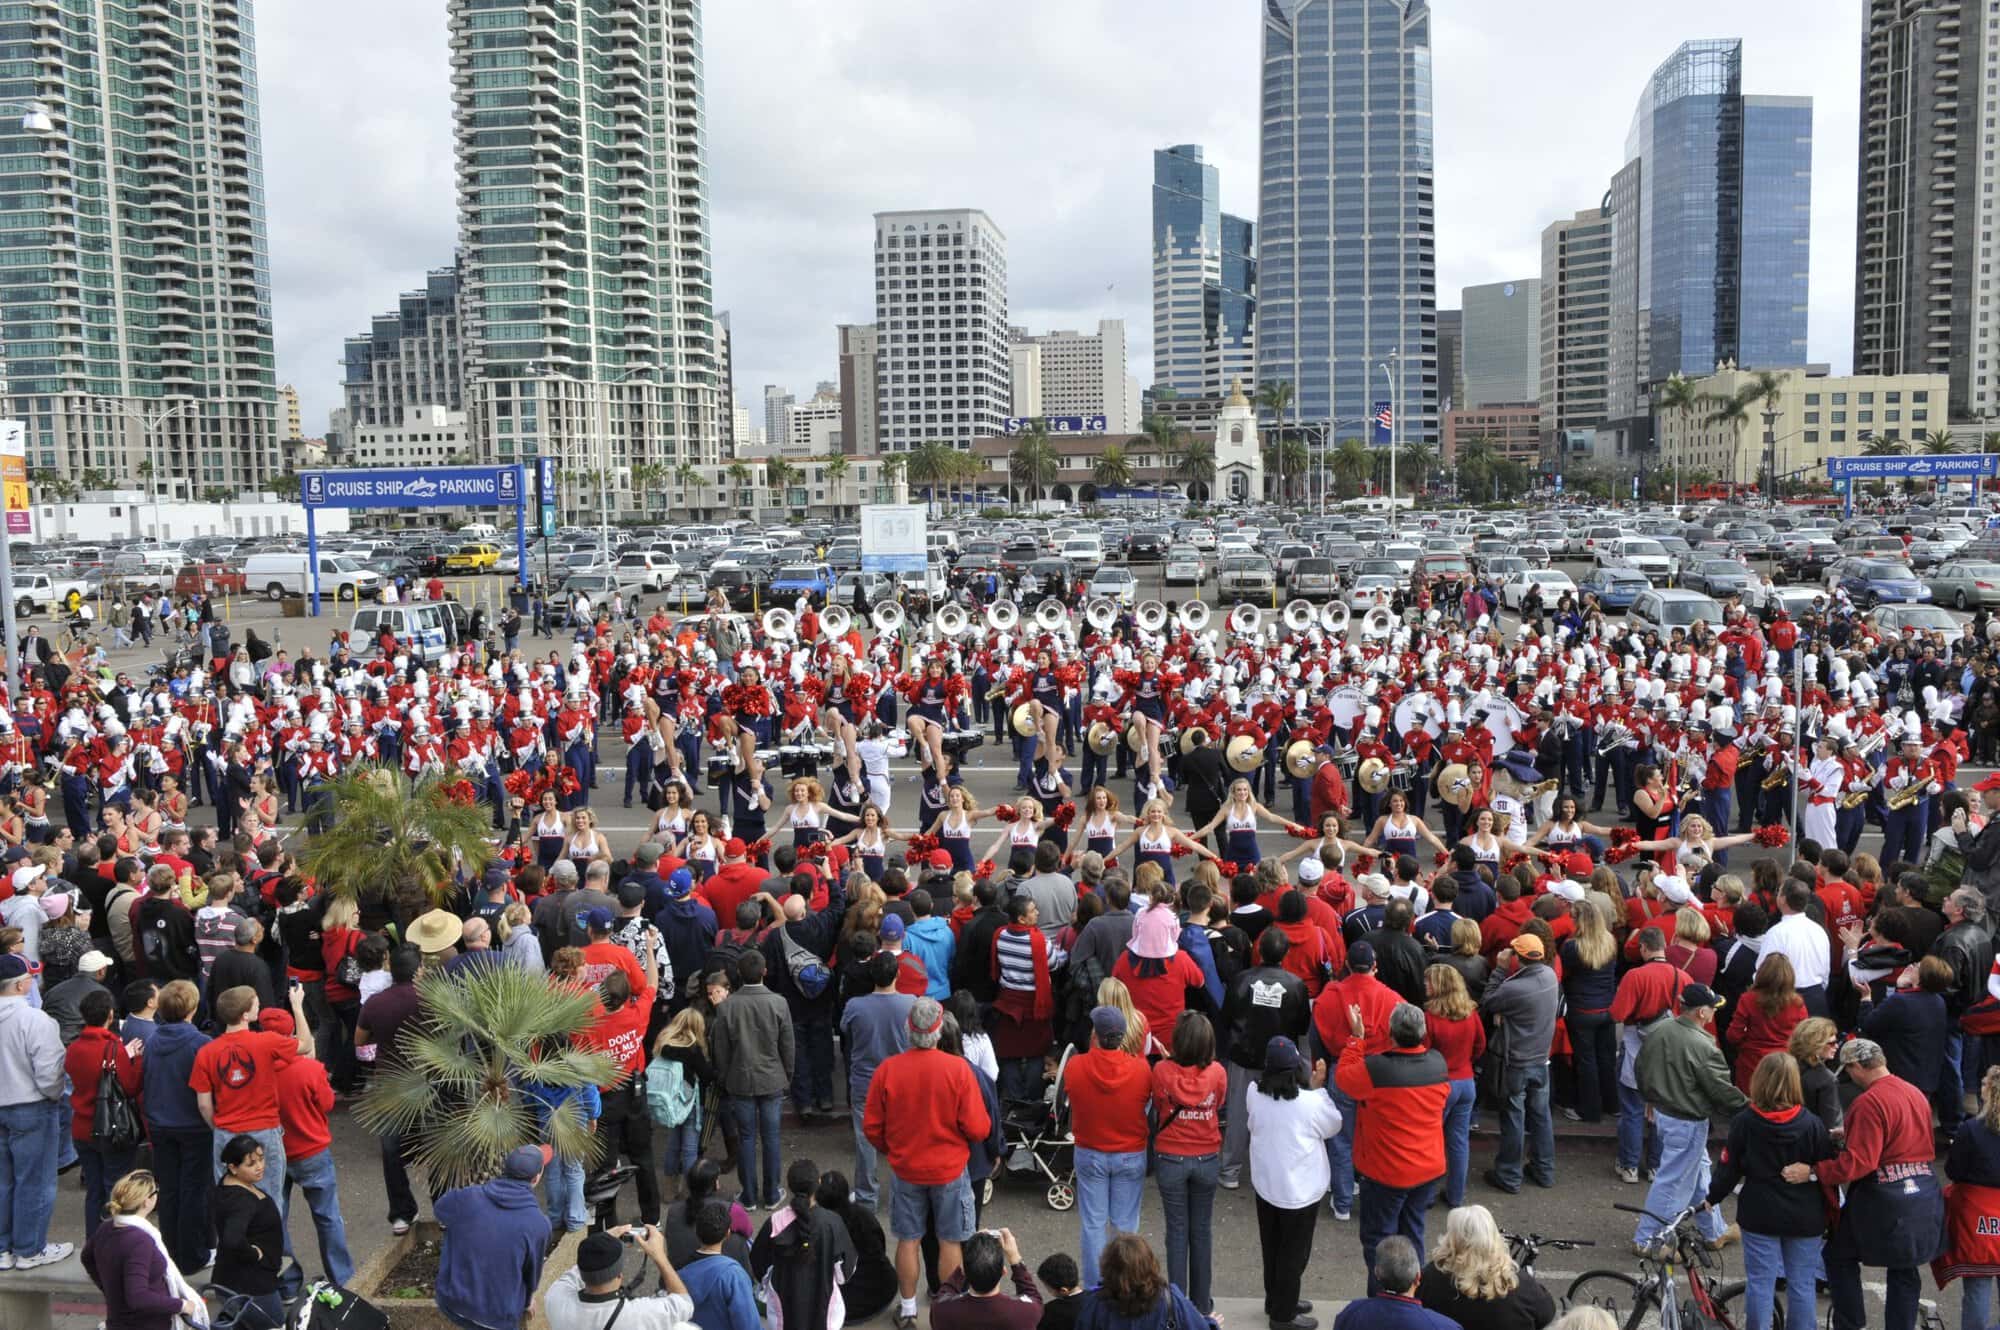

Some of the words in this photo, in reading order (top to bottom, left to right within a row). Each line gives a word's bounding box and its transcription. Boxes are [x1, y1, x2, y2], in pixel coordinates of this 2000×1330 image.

[1008, 418, 1070, 432] Sata
[1081, 417, 1103, 431] Fe
[543, 459, 552, 489] 5
[1846, 462, 1882, 472] CRUISE
[1884, 462, 1907, 471] SHIP
[1935, 460, 1979, 470] PARKING
[310, 477, 321, 493] 5
[327, 481, 373, 497] CRUISE
[375, 479, 403, 495] SHIP
[439, 478, 495, 494] PARKING
[501, 472, 513, 489] 5
[1836, 480, 1845, 490] P
[545, 510, 552, 531] P
[608, 1030, 636, 1048] DON'T
[622, 1041, 634, 1052] ME
